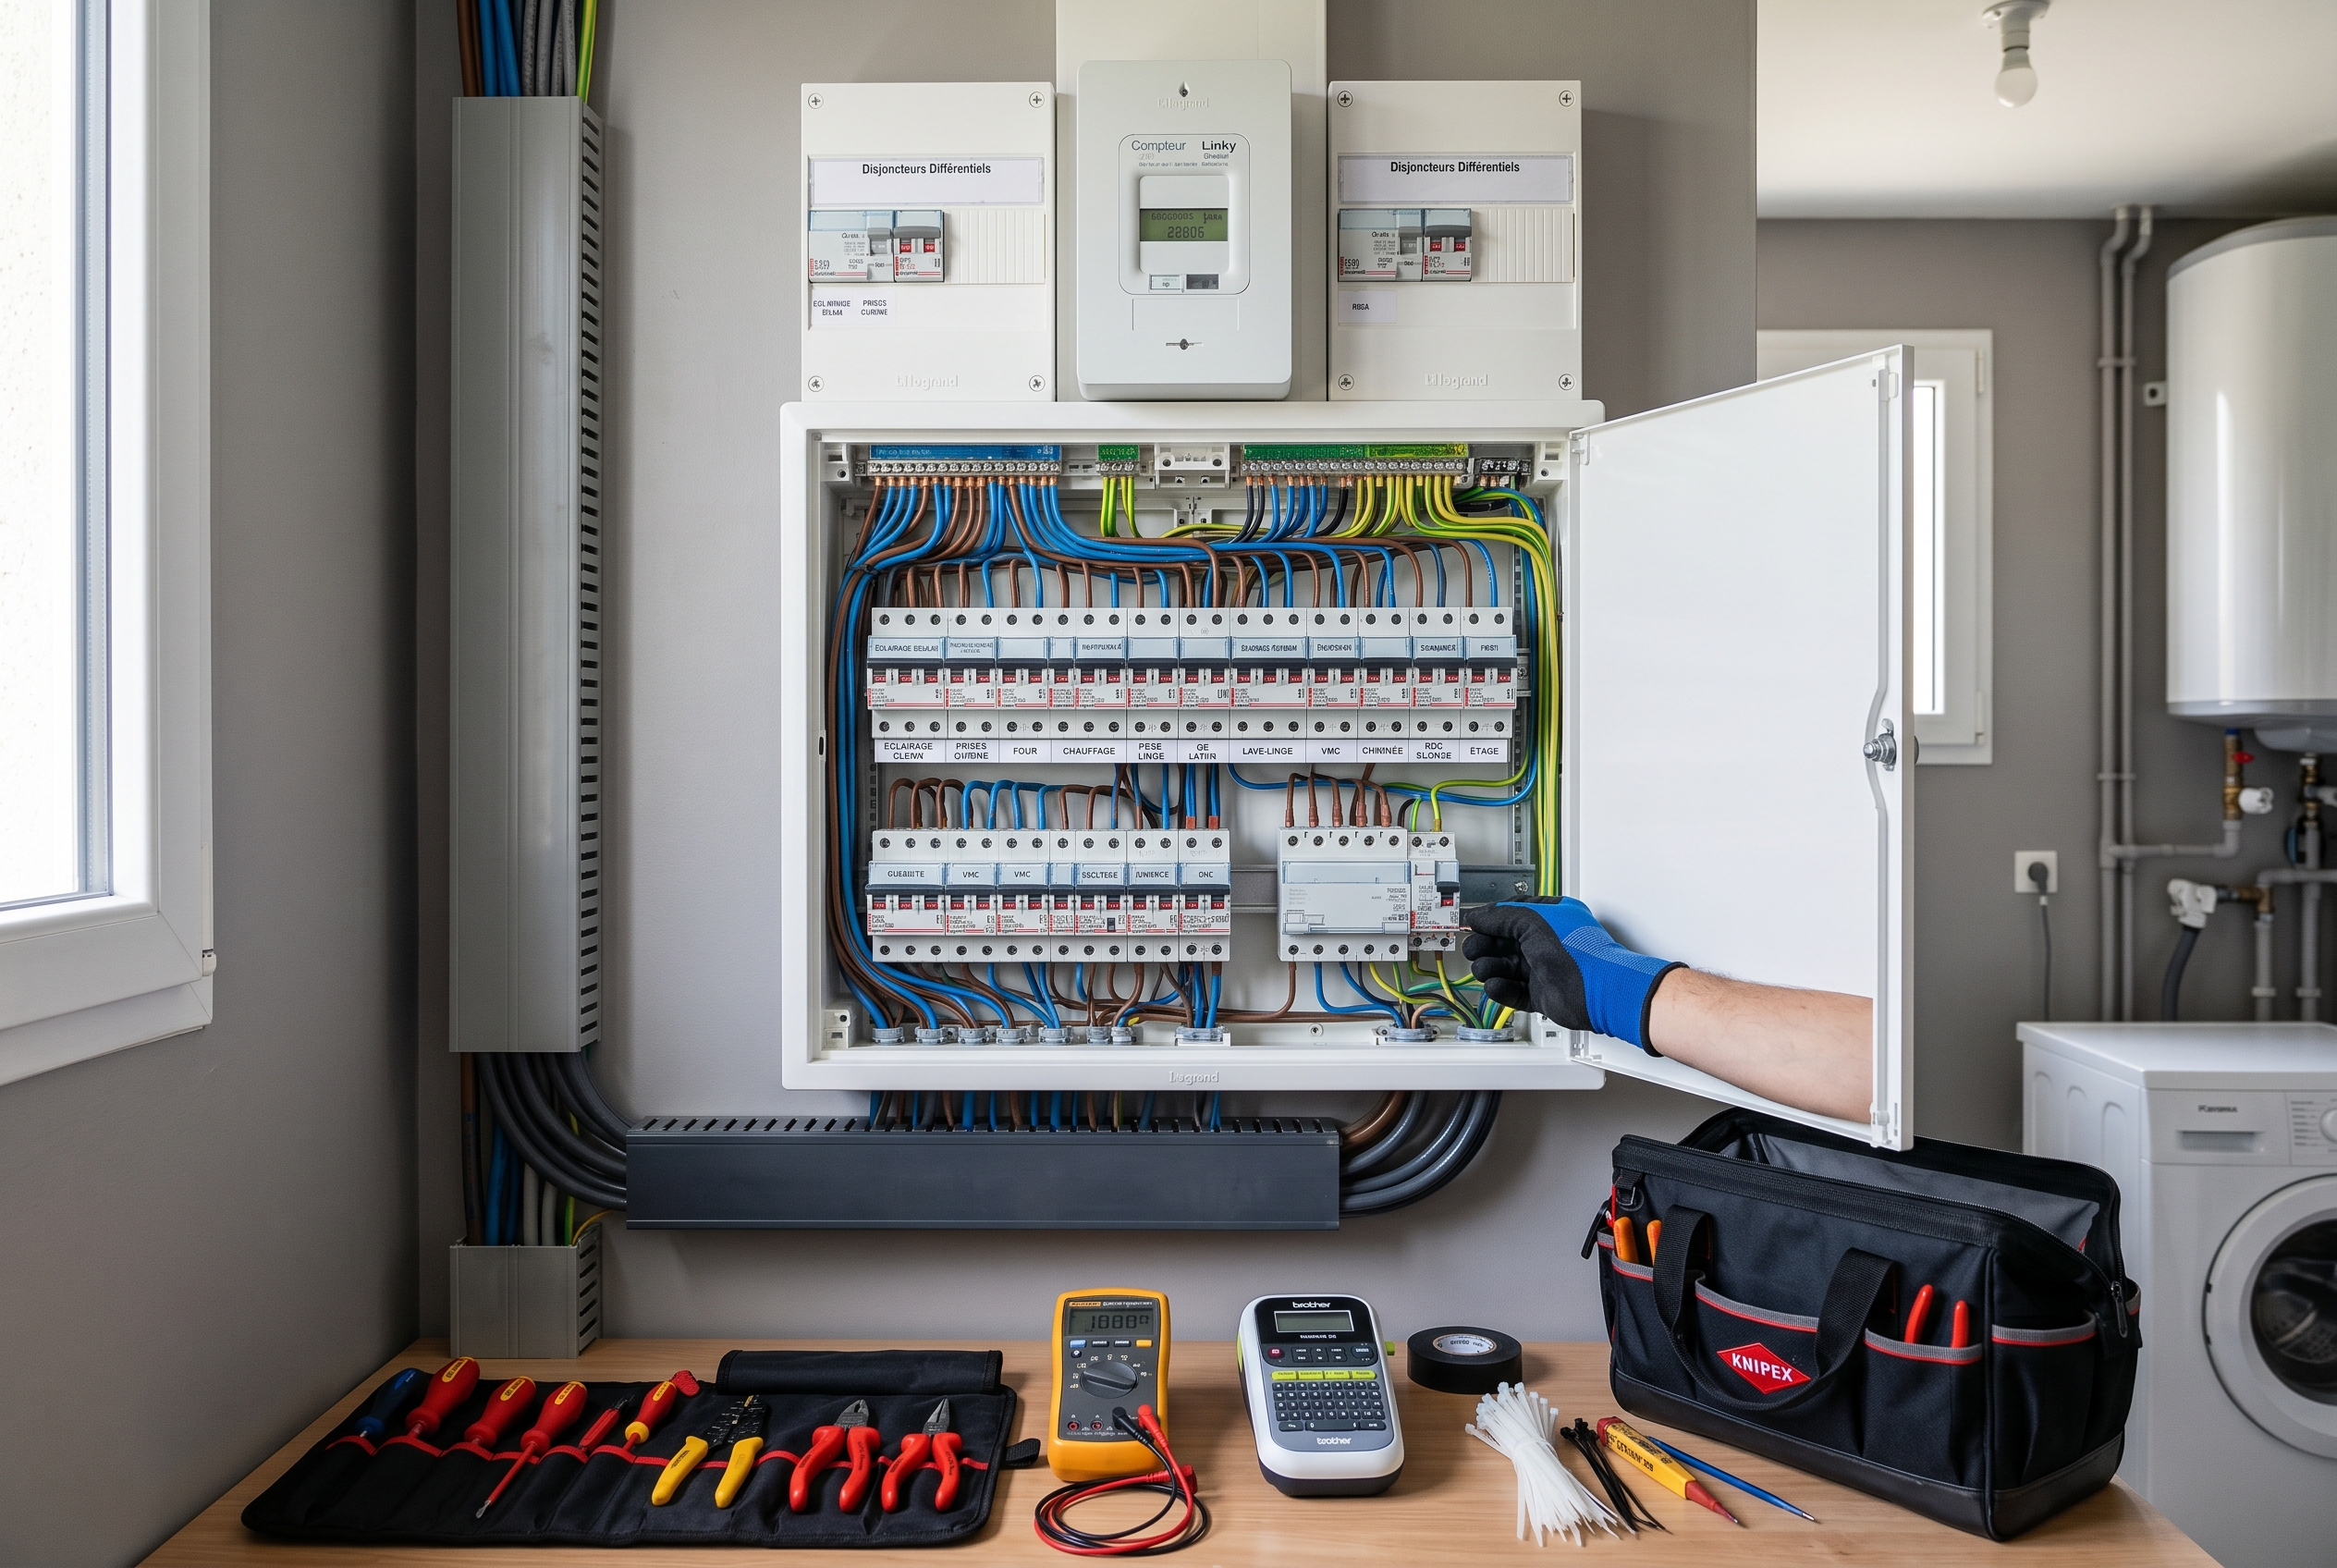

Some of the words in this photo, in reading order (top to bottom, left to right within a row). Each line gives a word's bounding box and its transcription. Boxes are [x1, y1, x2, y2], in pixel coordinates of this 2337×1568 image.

[1131, 140, 1187, 153] Compteur
[1202, 140, 1237, 153] Linky
[862, 163, 927, 177] Disjoncteurs
[929, 162, 992, 174] Différentiels
[1390, 161, 1456, 175] Disjoncteurs
[1458, 161, 1521, 172] Différentiels
[956, 742, 987, 751] PRISES
[1138, 742, 1162, 751] PESE
[1425, 741, 1443, 750] RDC
[1013, 747, 1038, 755] FOUR
[1062, 747, 1116, 755] CHAUFFAGE
[1242, 747, 1293, 755] LAVE-LINGE
[1321, 747, 1340, 755] VMC
[1014, 870, 1031, 878] VMC
[1731, 1353, 1793, 1382] KNIPEX
